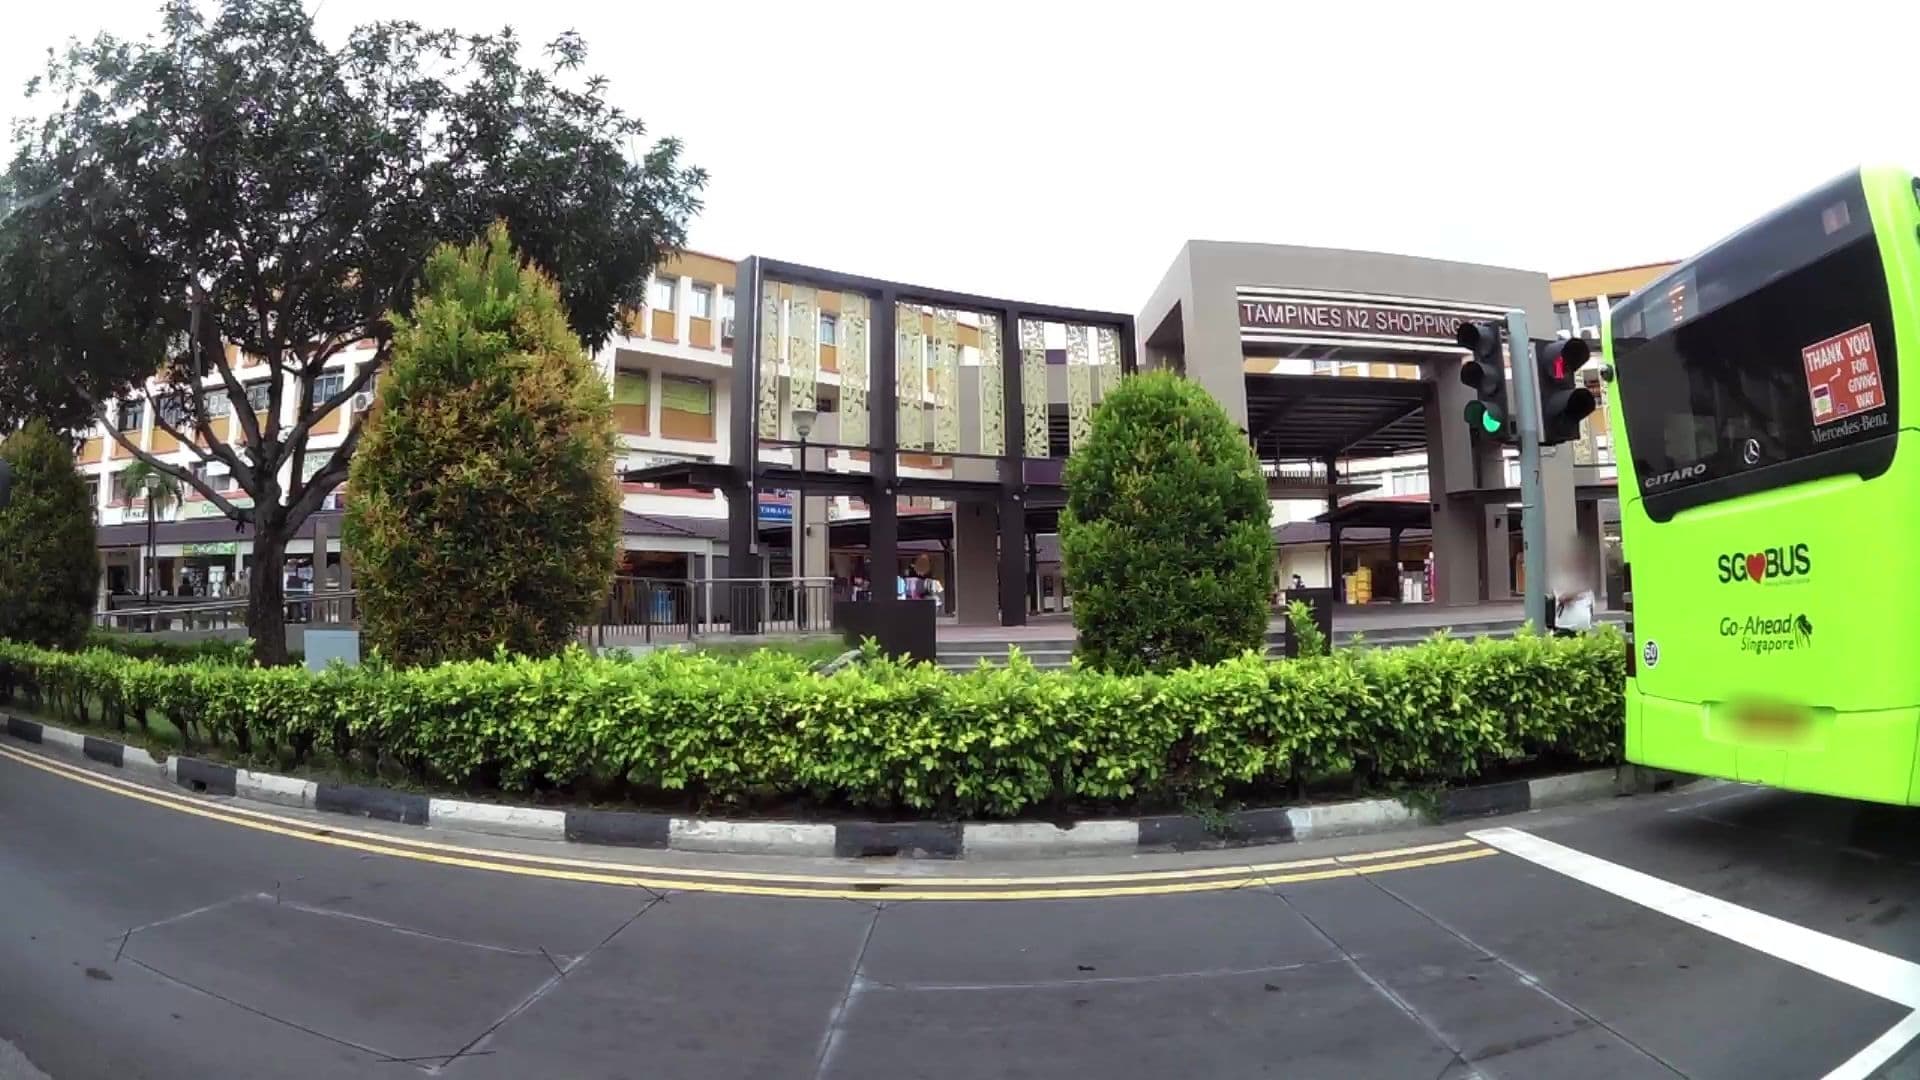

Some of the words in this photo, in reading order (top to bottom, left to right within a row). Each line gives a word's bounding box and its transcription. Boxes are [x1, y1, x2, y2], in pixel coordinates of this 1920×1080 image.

[1243, 303, 1341, 328] TAMPINES
[1346, 309, 1370, 329] N2
[1375, 311, 1461, 335] SHOPPING
[1806, 341, 1844, 372] THANK
[1845, 331, 1871, 357] YOU
[1851, 357, 1869, 375] FOR
[1848, 371, 1877, 393] GIVING
[1855, 391, 1874, 409] WAY
[1811, 413, 1888, 443] Mercedes-Benz
[1645, 463, 1706, 488] CITARO
[1720, 613, 1792, 636] Go-Ahead
[1741, 637, 1794, 655] Singapore
